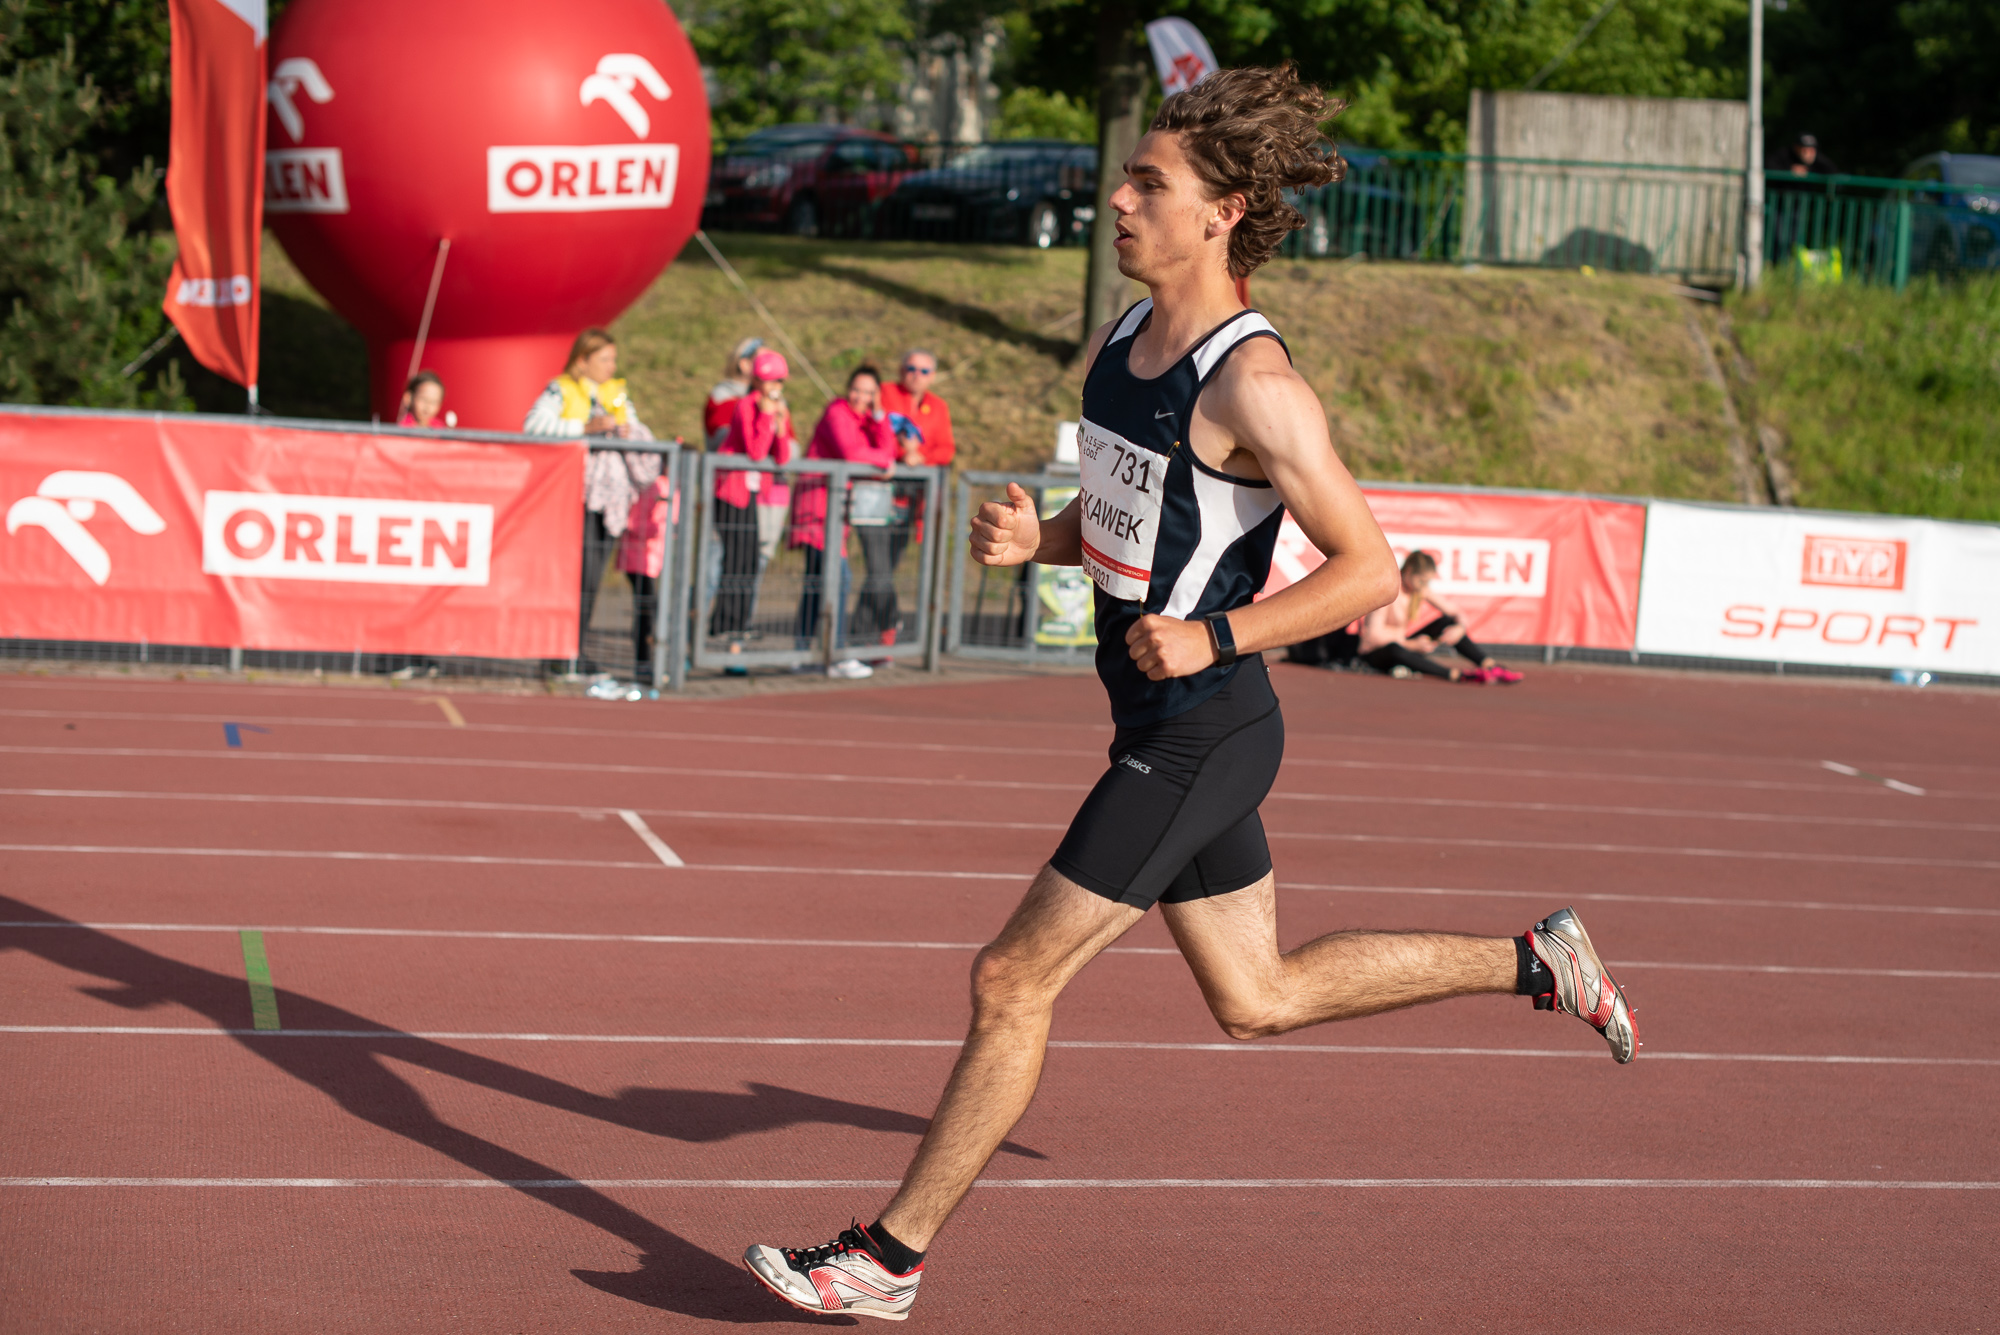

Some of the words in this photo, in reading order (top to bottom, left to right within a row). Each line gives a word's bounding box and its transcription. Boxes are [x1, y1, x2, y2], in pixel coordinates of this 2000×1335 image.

[505, 157, 666, 198] ORLEN
[1085, 435, 1098, 447] AZS
[1110, 443, 1151, 494] 731
[223, 508, 470, 569] ORLEN
[1092, 564, 1110, 589] 2021
[1392, 546, 1534, 584] LEN
[1815, 544, 1893, 582] TVP
[1721, 604, 1979, 650] SPORT
[1126, 758, 1152, 775] asics
